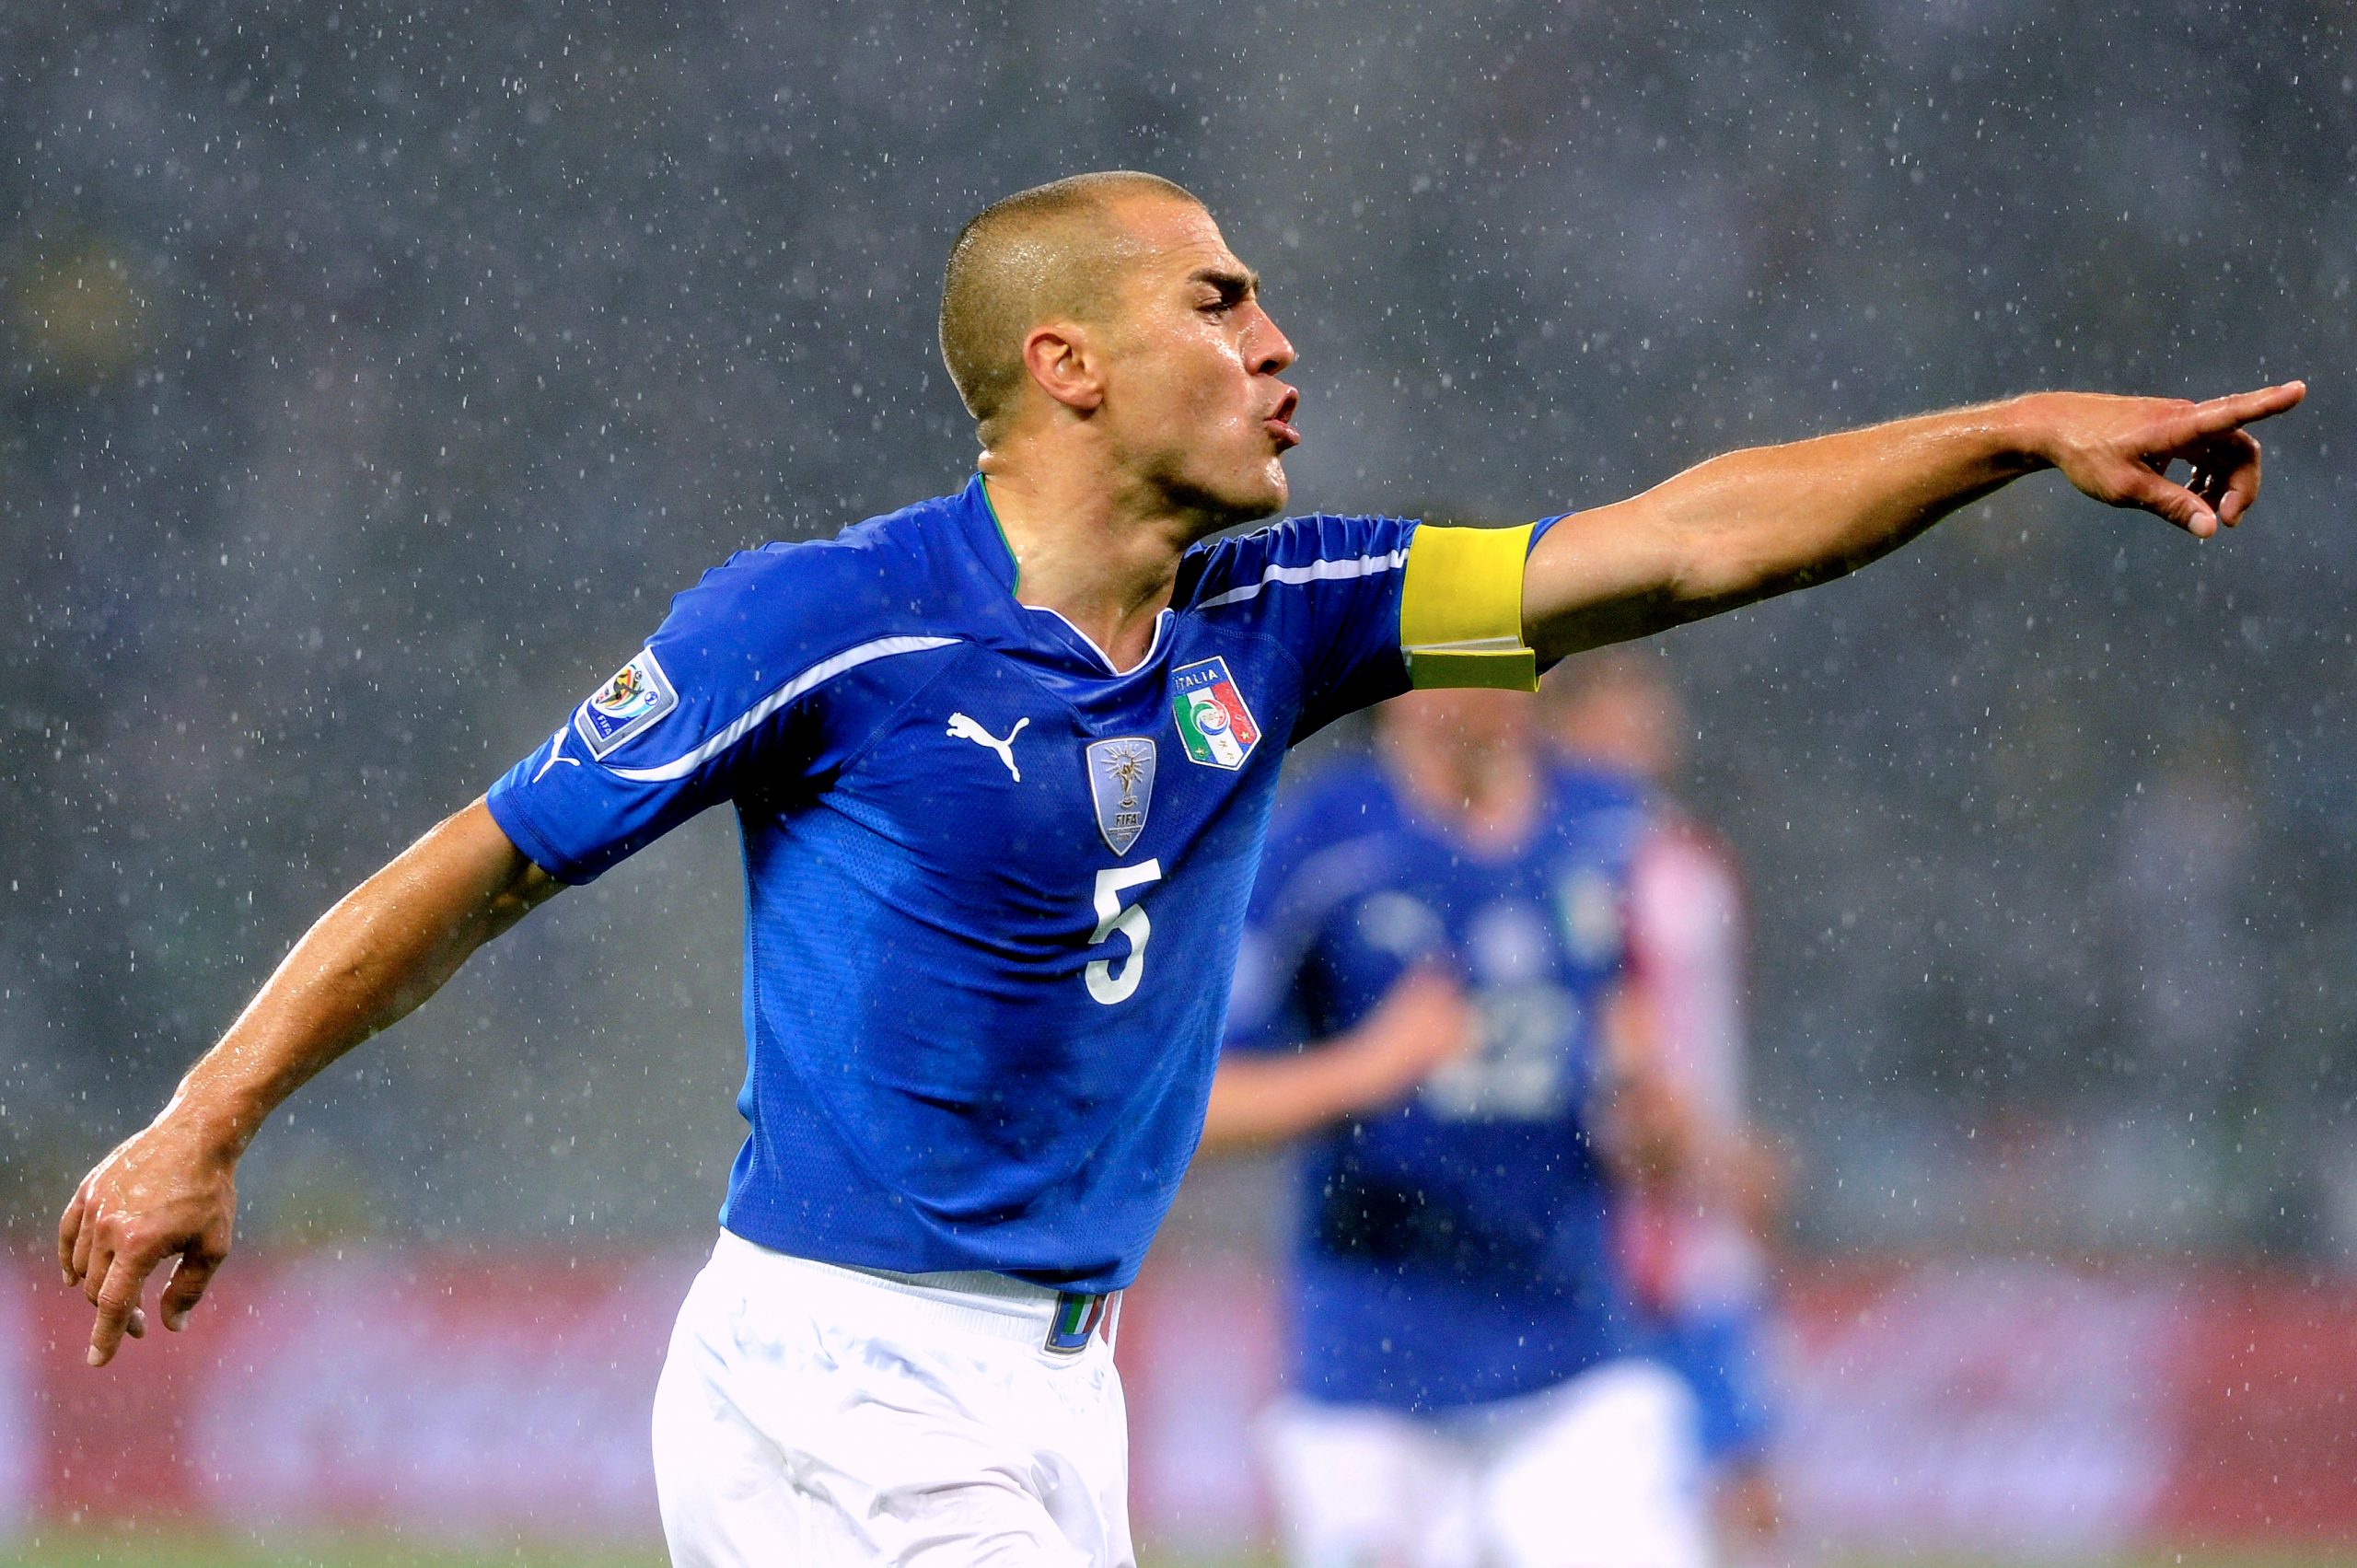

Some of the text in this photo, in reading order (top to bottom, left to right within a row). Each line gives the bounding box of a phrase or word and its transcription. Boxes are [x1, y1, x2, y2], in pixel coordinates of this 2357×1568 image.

[1175, 668, 1219, 691] ITALIA
[597, 714, 612, 736] FIFA
[1115, 812, 1138, 826] FIFA
[1085, 857, 1162, 1005] 5
